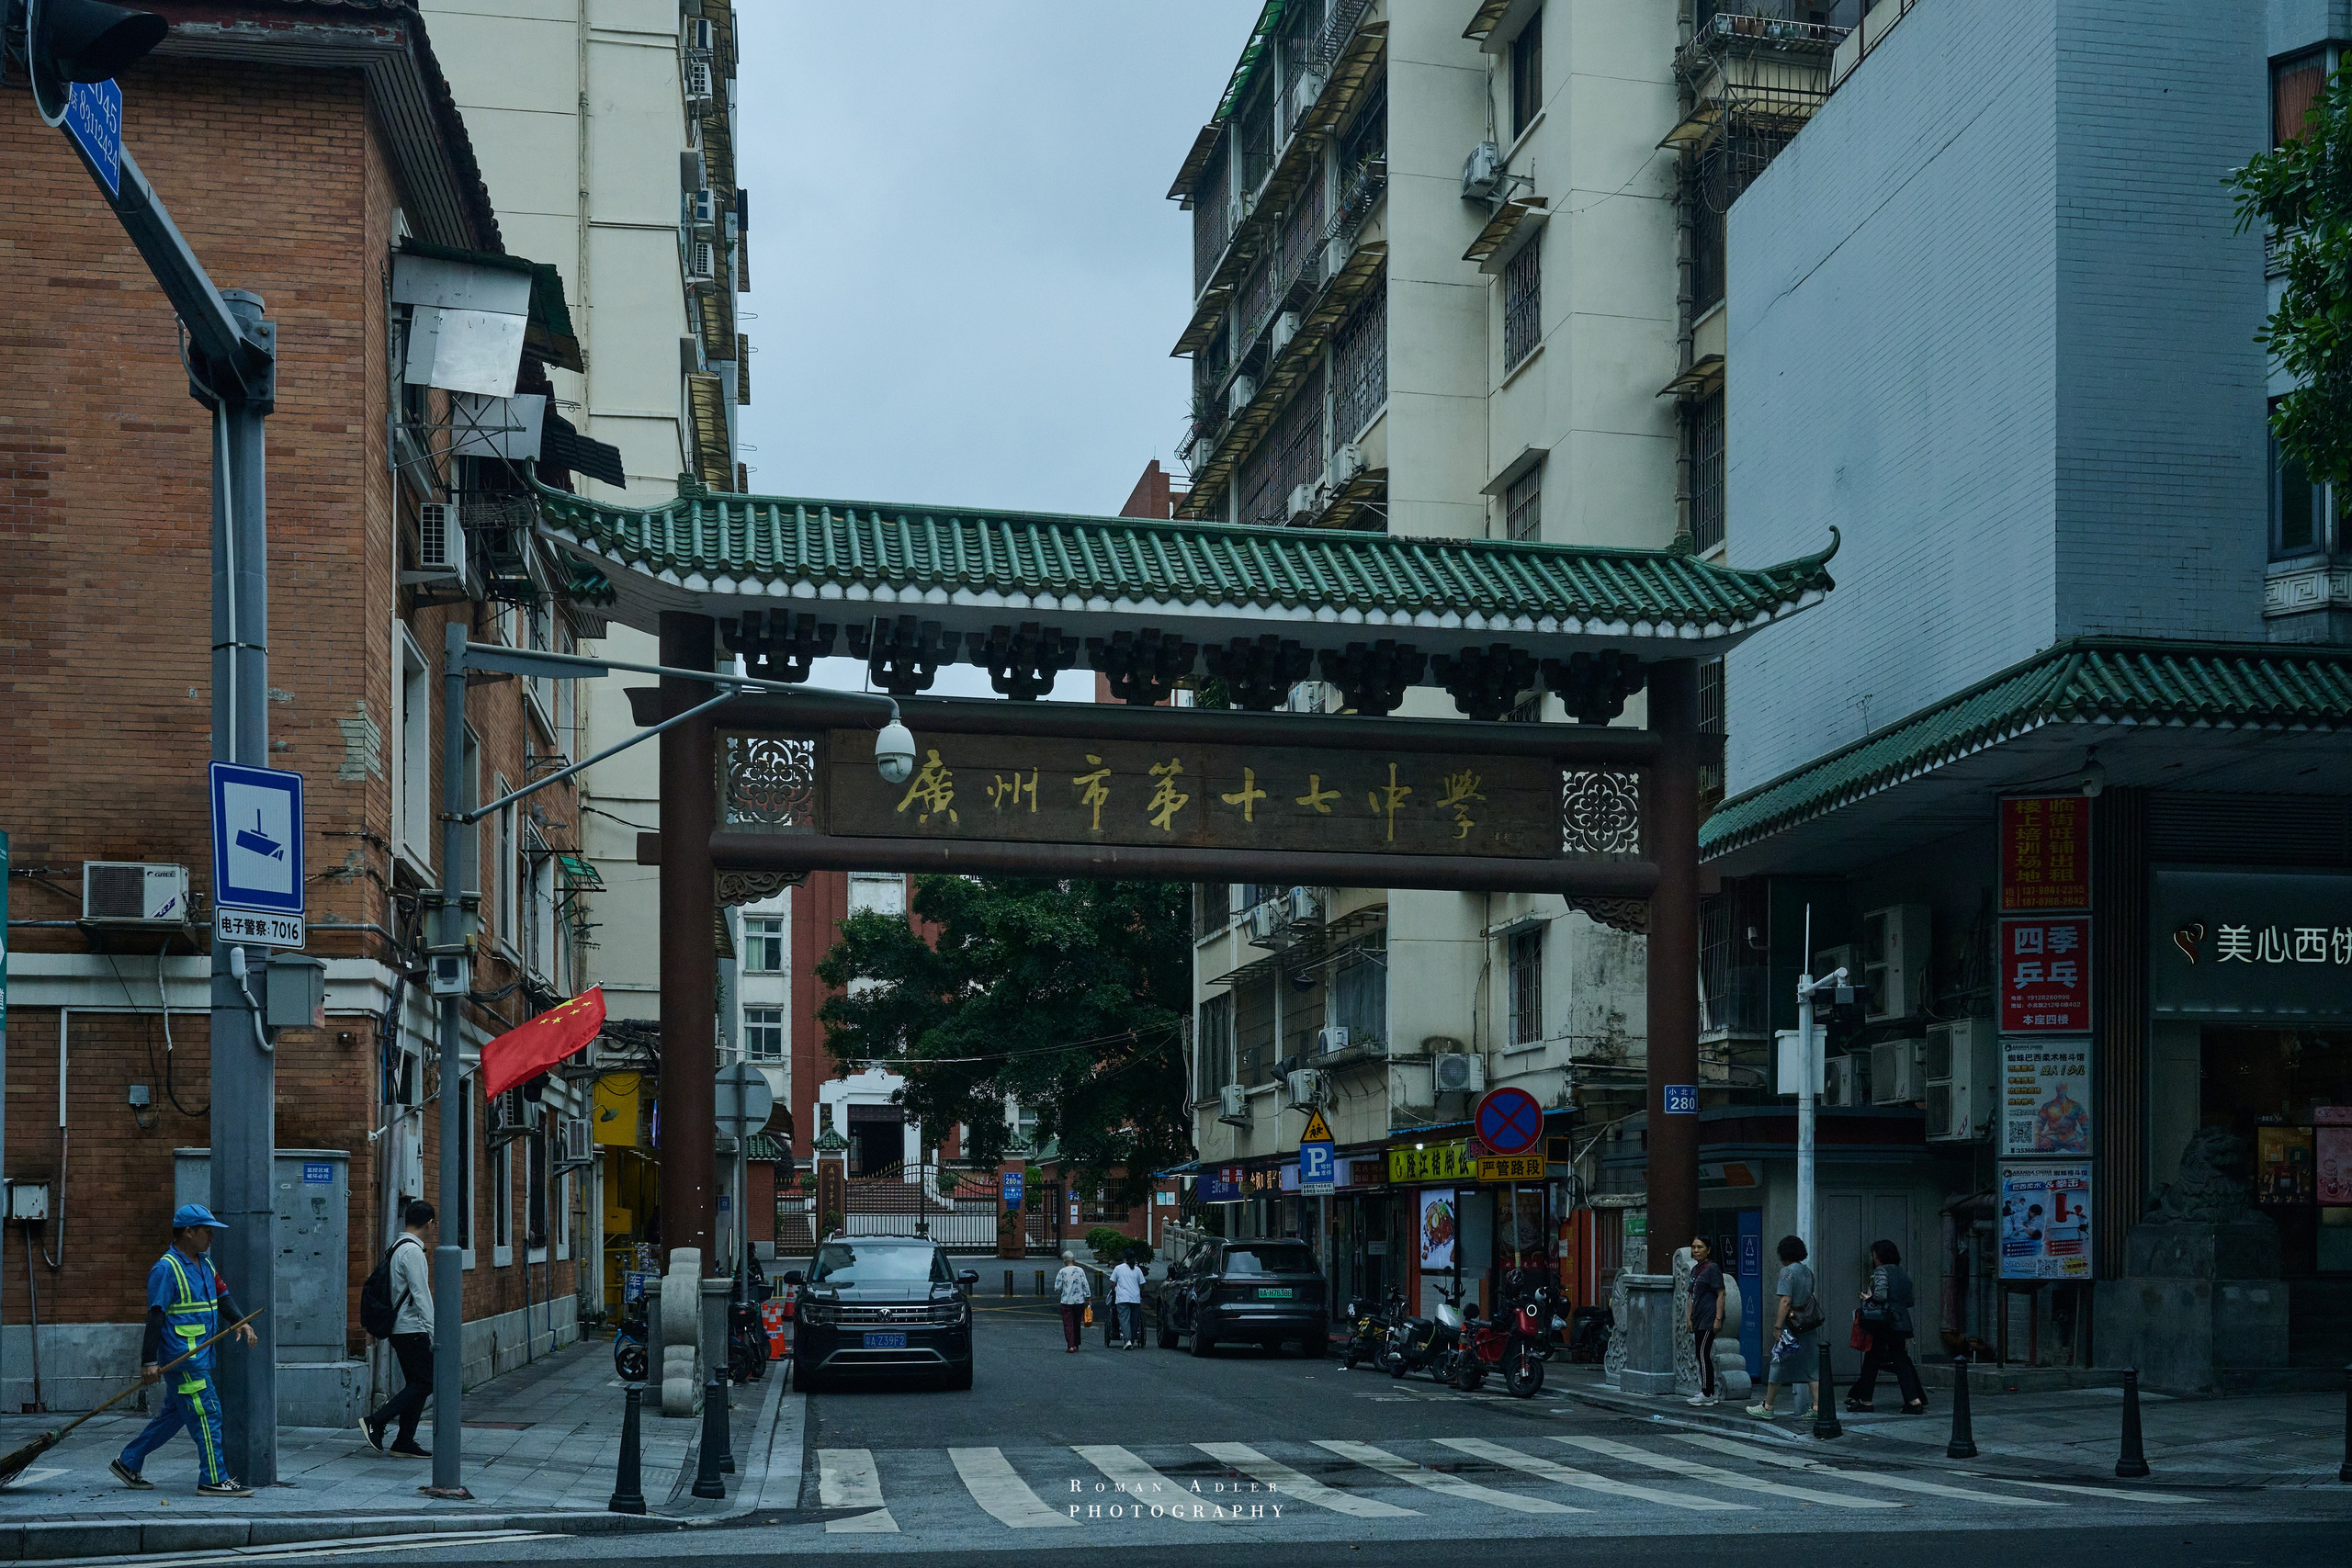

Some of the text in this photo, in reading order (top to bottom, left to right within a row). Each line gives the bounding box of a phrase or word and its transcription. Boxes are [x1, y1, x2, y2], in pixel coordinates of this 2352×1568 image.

[79, 90, 118, 176] 83112424
[2015, 799, 2041, 882] 楼上培训场地
[2049, 799, 2075, 882] 临街旺铺出租
[221, 917, 299, 940] 电子警察:7016
[2015, 926, 2078, 955] 四季
[2217, 923, 2352, 964] 美心西饼
[2013, 960, 2078, 989] 乒乓
[2022, 1014, 2069, 1025] 本座四楼
[2007, 1053, 2085, 1062] 蜘蛛巴西柔术格斗馆
[1670, 1097, 1695, 1110] 280
[1307, 1147, 1328, 1177] P
[1482, 1160, 1540, 1177] 严管路段
